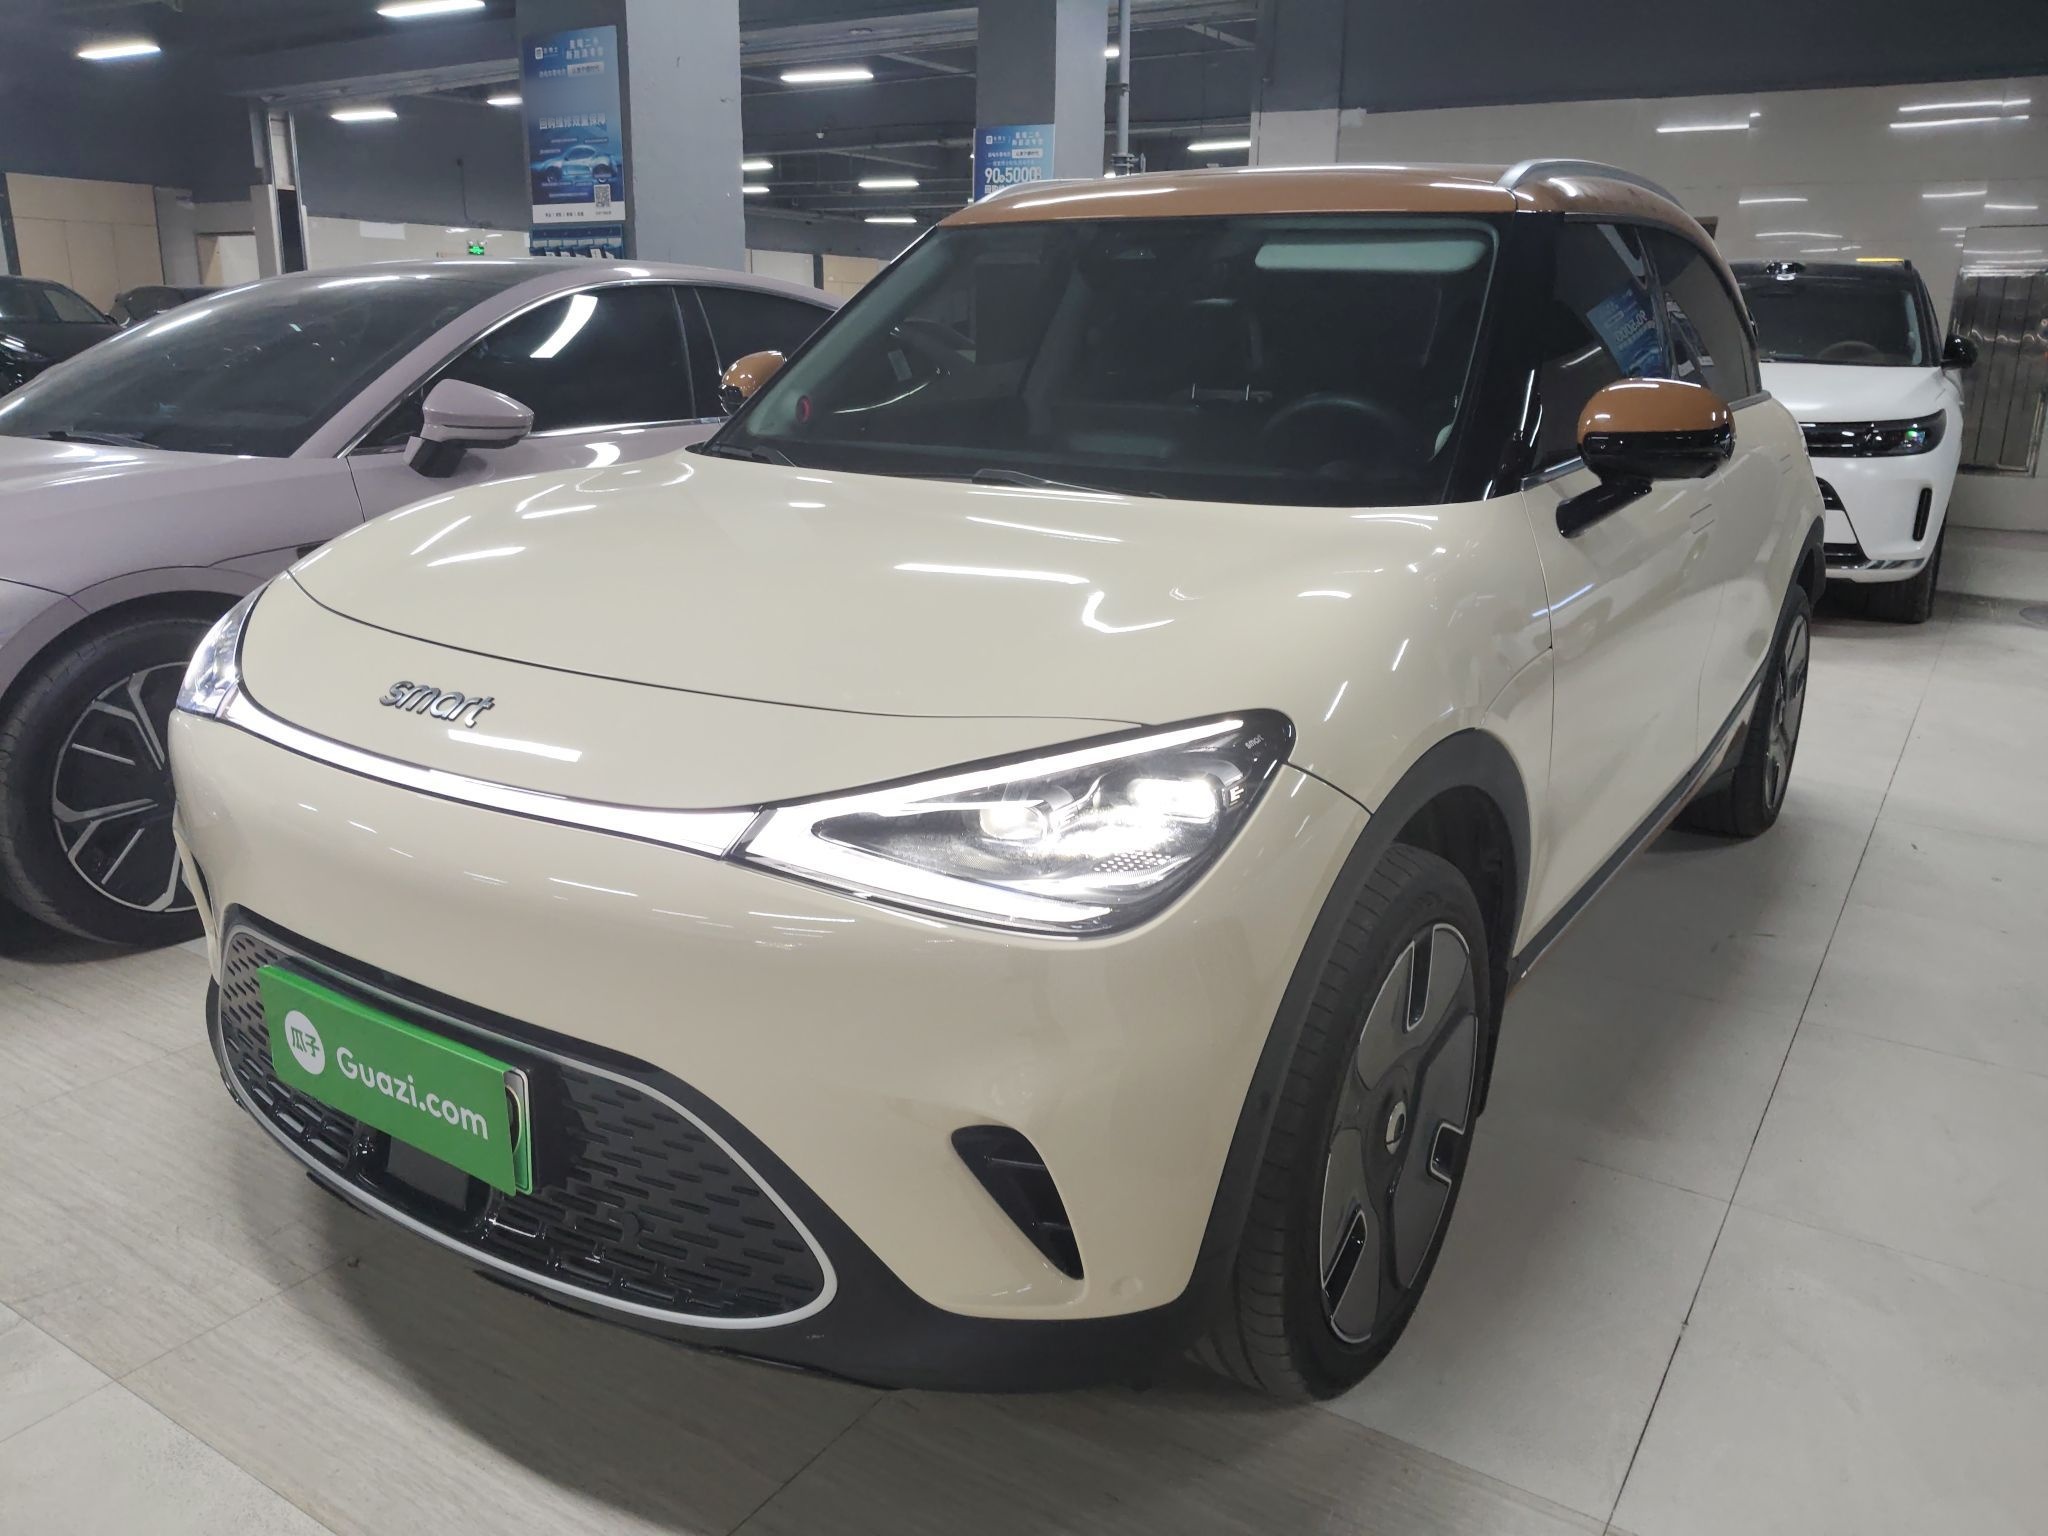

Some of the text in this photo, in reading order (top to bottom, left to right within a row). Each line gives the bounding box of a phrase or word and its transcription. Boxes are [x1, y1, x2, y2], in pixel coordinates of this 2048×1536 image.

[379, 681, 495, 728] smart
[1245, 734, 1265, 749] smart
[290, 1025, 320, 1060] 瓜子
[336, 1046, 490, 1140] Guazi.com
